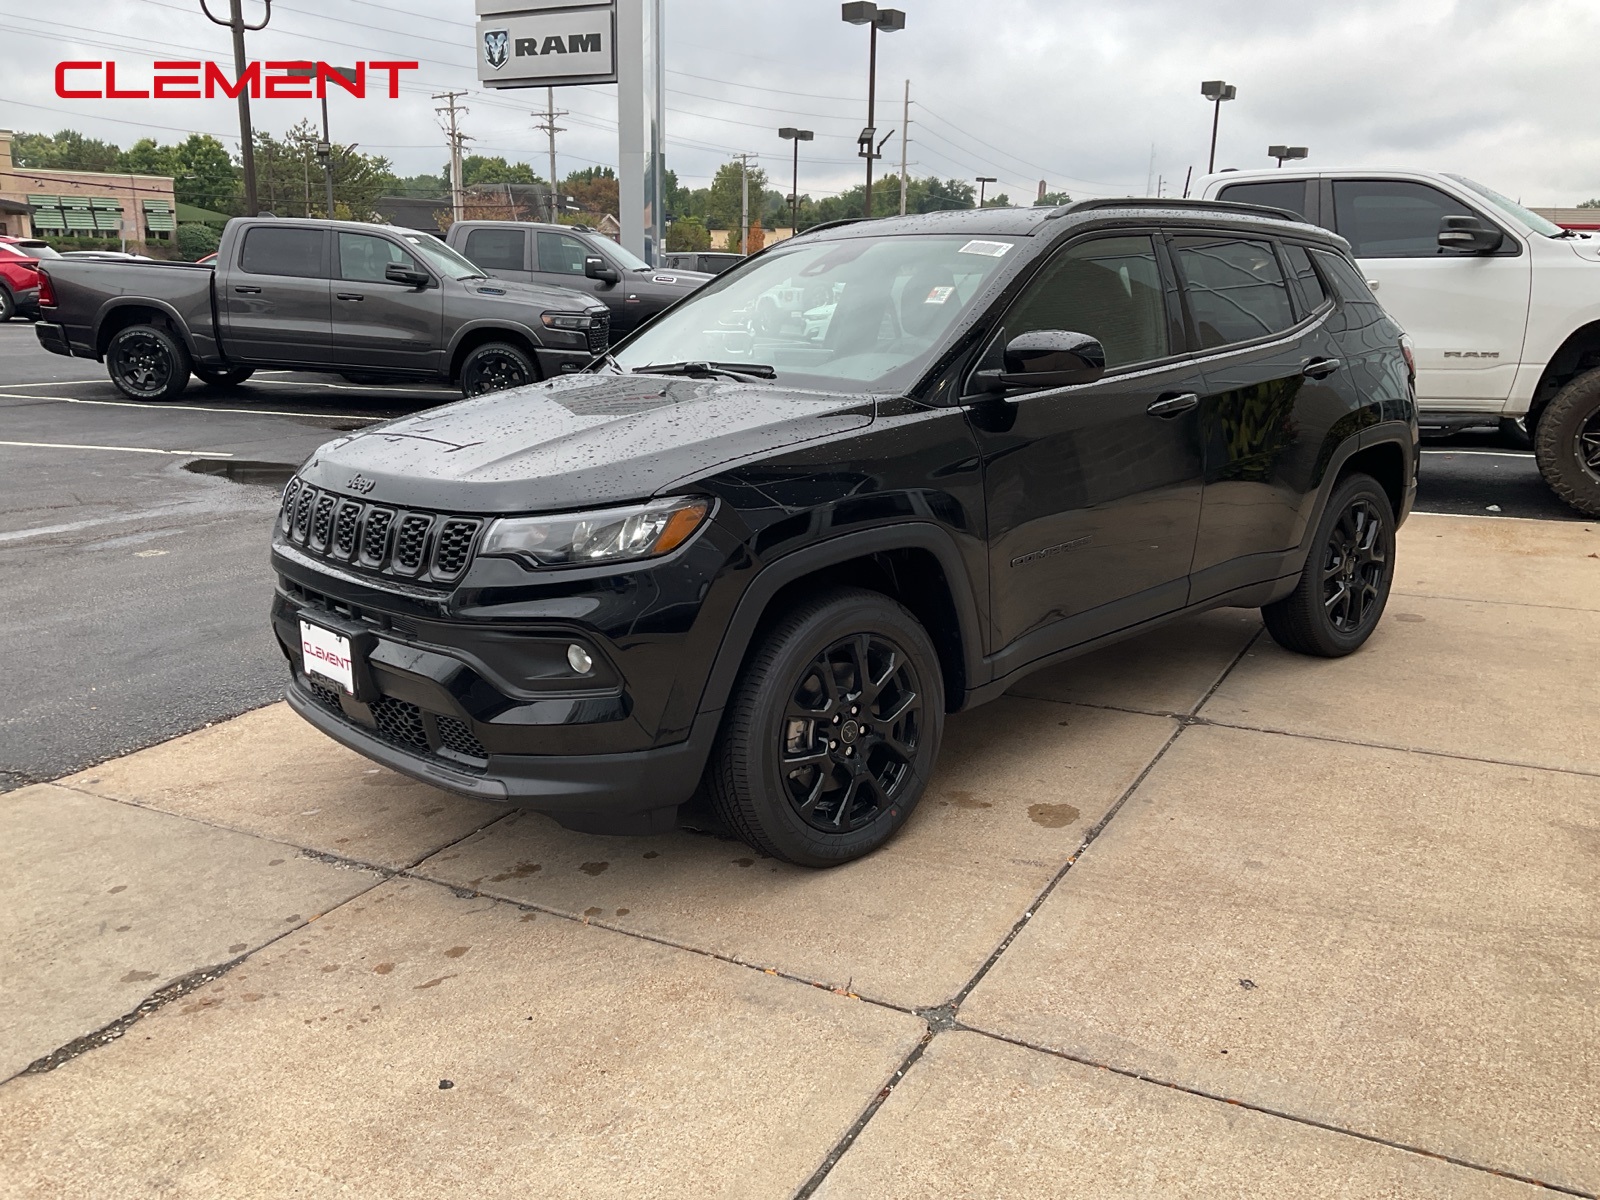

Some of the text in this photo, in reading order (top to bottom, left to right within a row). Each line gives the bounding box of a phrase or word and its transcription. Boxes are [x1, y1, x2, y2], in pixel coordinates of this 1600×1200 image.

[515, 33, 601, 57] RAM
[1443, 351, 1500, 359] RAM
[346, 473, 376, 494] Jeep
[303, 641, 352, 671] CLEMENT
